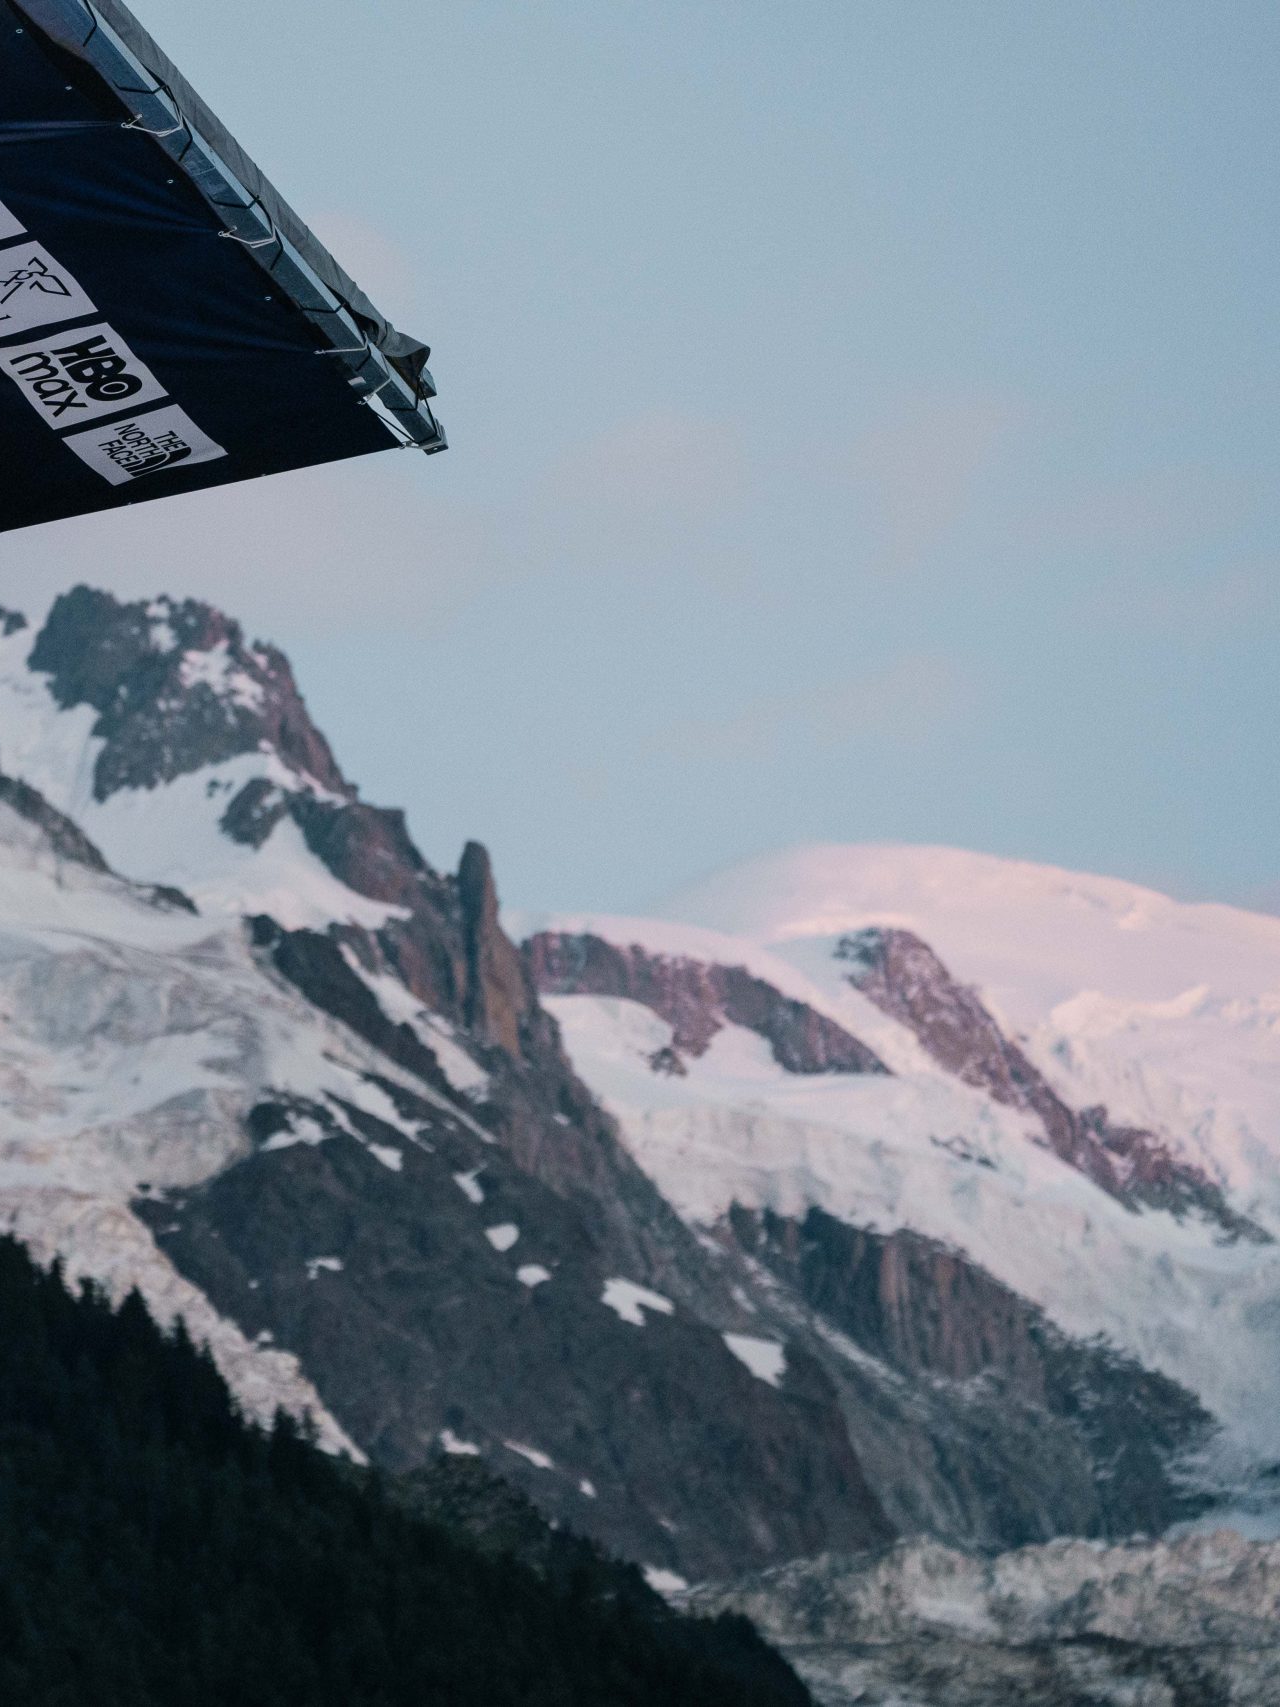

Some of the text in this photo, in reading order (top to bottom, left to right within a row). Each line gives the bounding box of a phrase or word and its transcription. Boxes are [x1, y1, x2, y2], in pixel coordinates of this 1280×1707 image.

[10, 352, 88, 418] max
[50, 334, 142, 401] HBO
[98, 440, 140, 465] FACE
[114, 423, 164, 458] NORTH
[154, 430, 188, 452] THE
